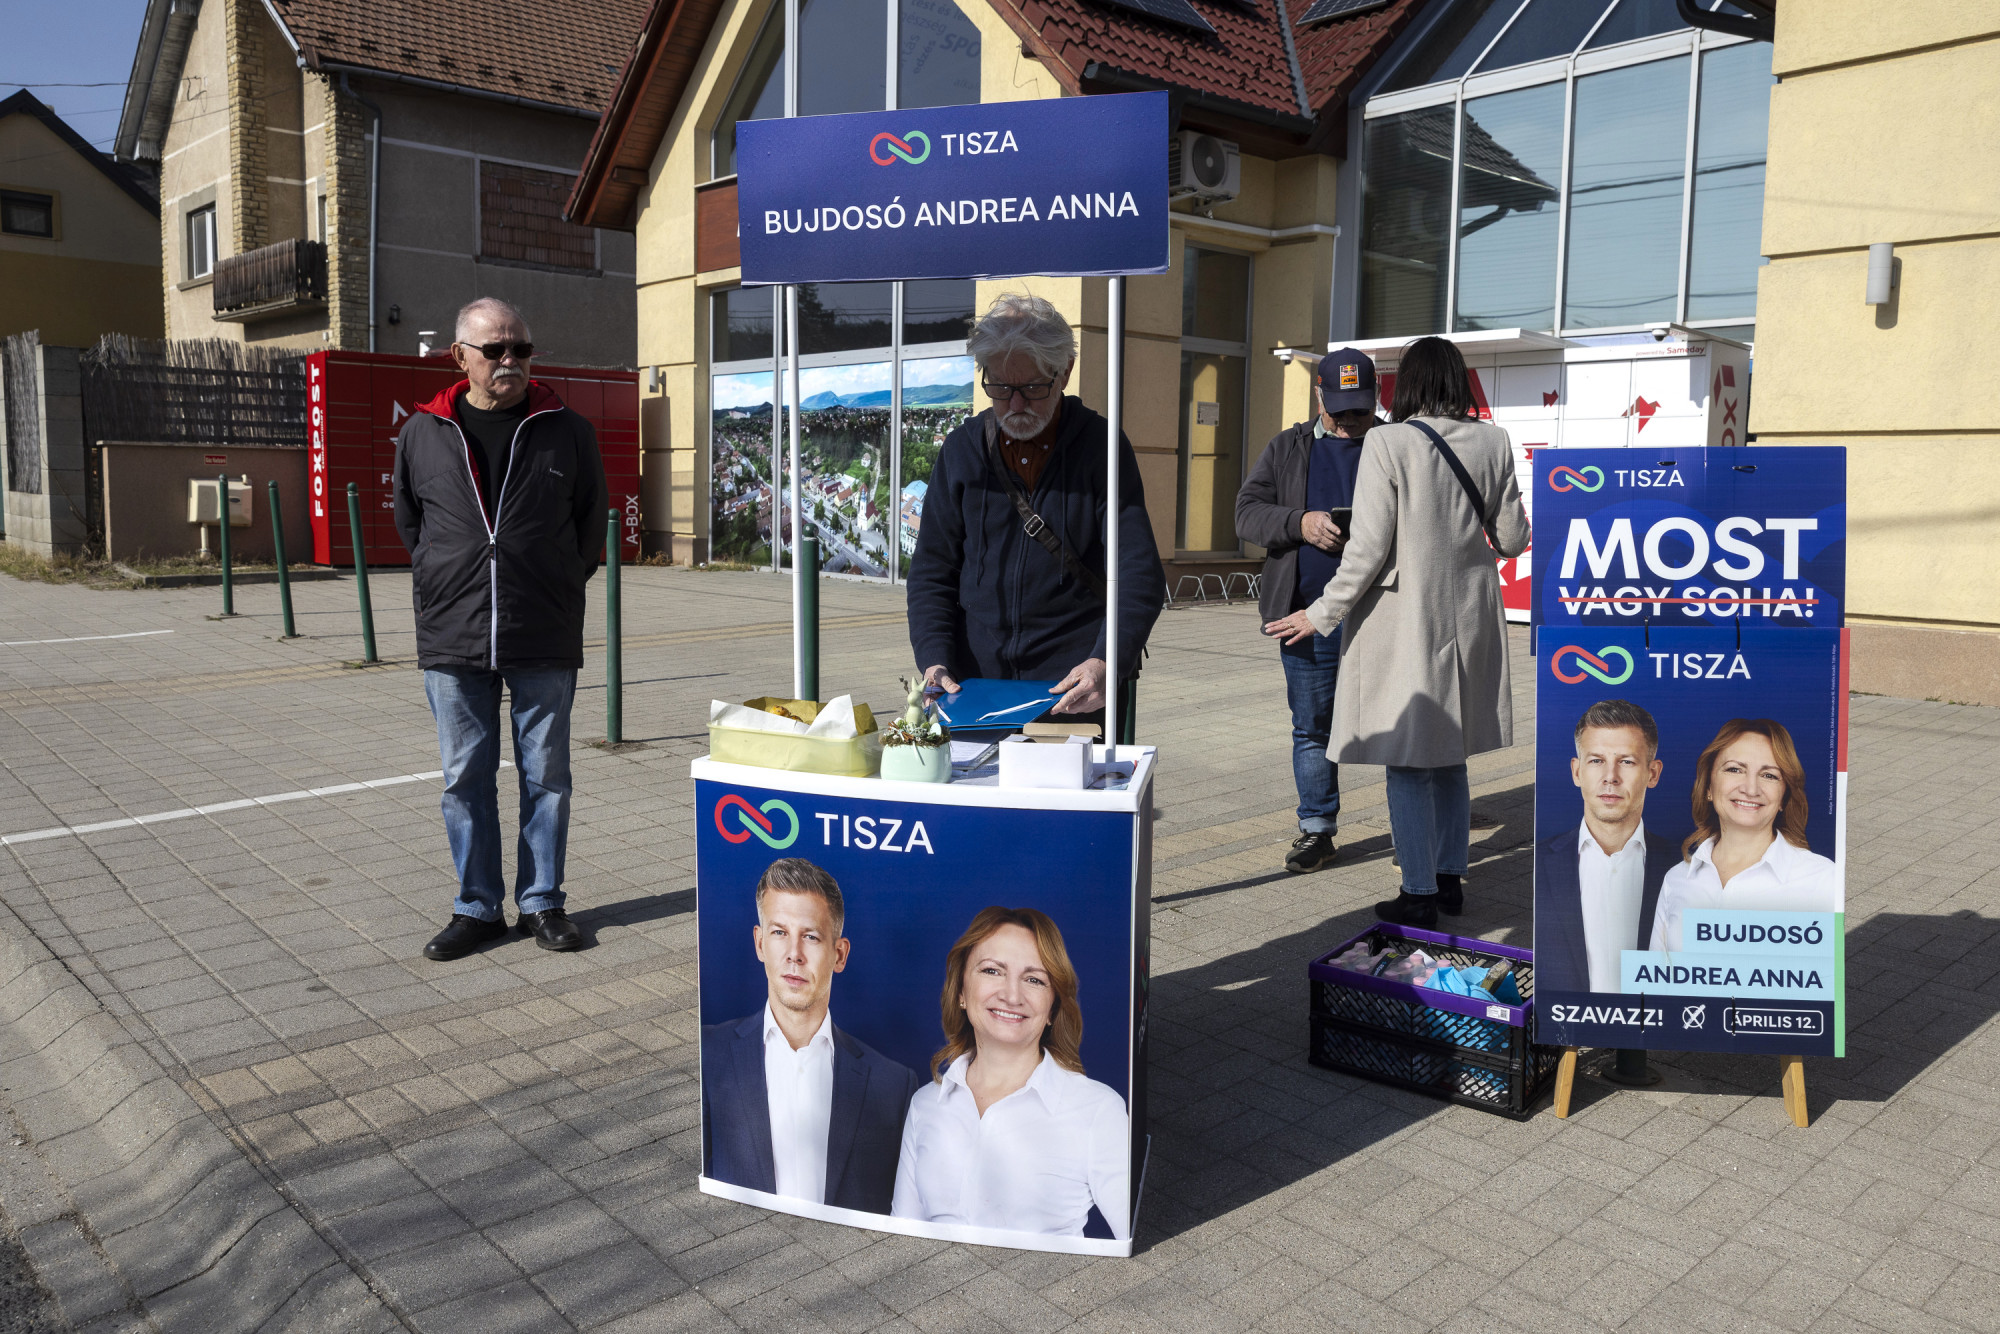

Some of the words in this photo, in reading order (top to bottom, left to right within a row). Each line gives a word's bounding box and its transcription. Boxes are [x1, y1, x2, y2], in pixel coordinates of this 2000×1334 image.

[940, 130, 1019, 157] TISZA
[764, 195, 906, 235] BUJDOSÓ
[913, 196, 1040, 227] ANDREA
[1047, 191, 1140, 221] ANNA
[1666, 345, 1705, 355] Sameday
[311, 363, 323, 517] FOXPOST
[1614, 469, 1685, 488] TISZA
[625, 494, 639, 545] A-BOX
[1559, 516, 1818, 581] MOST
[1558, 586, 1672, 617] VAGY
[1681, 586, 1816, 618] SOHA!
[1648, 652, 1752, 680] TISZA
[815, 812, 934, 855] TISZA
[1696, 921, 1824, 946] BUJDOSÓ
[1634, 964, 1742, 988] ANDREA
[1748, 968, 1824, 989] ANNA
[1551, 1004, 1664, 1026] SZAVAZZ!
[1731, 1010, 1793, 1029] ÁPRILIS
[1796, 1015, 1817, 1030] 12.
